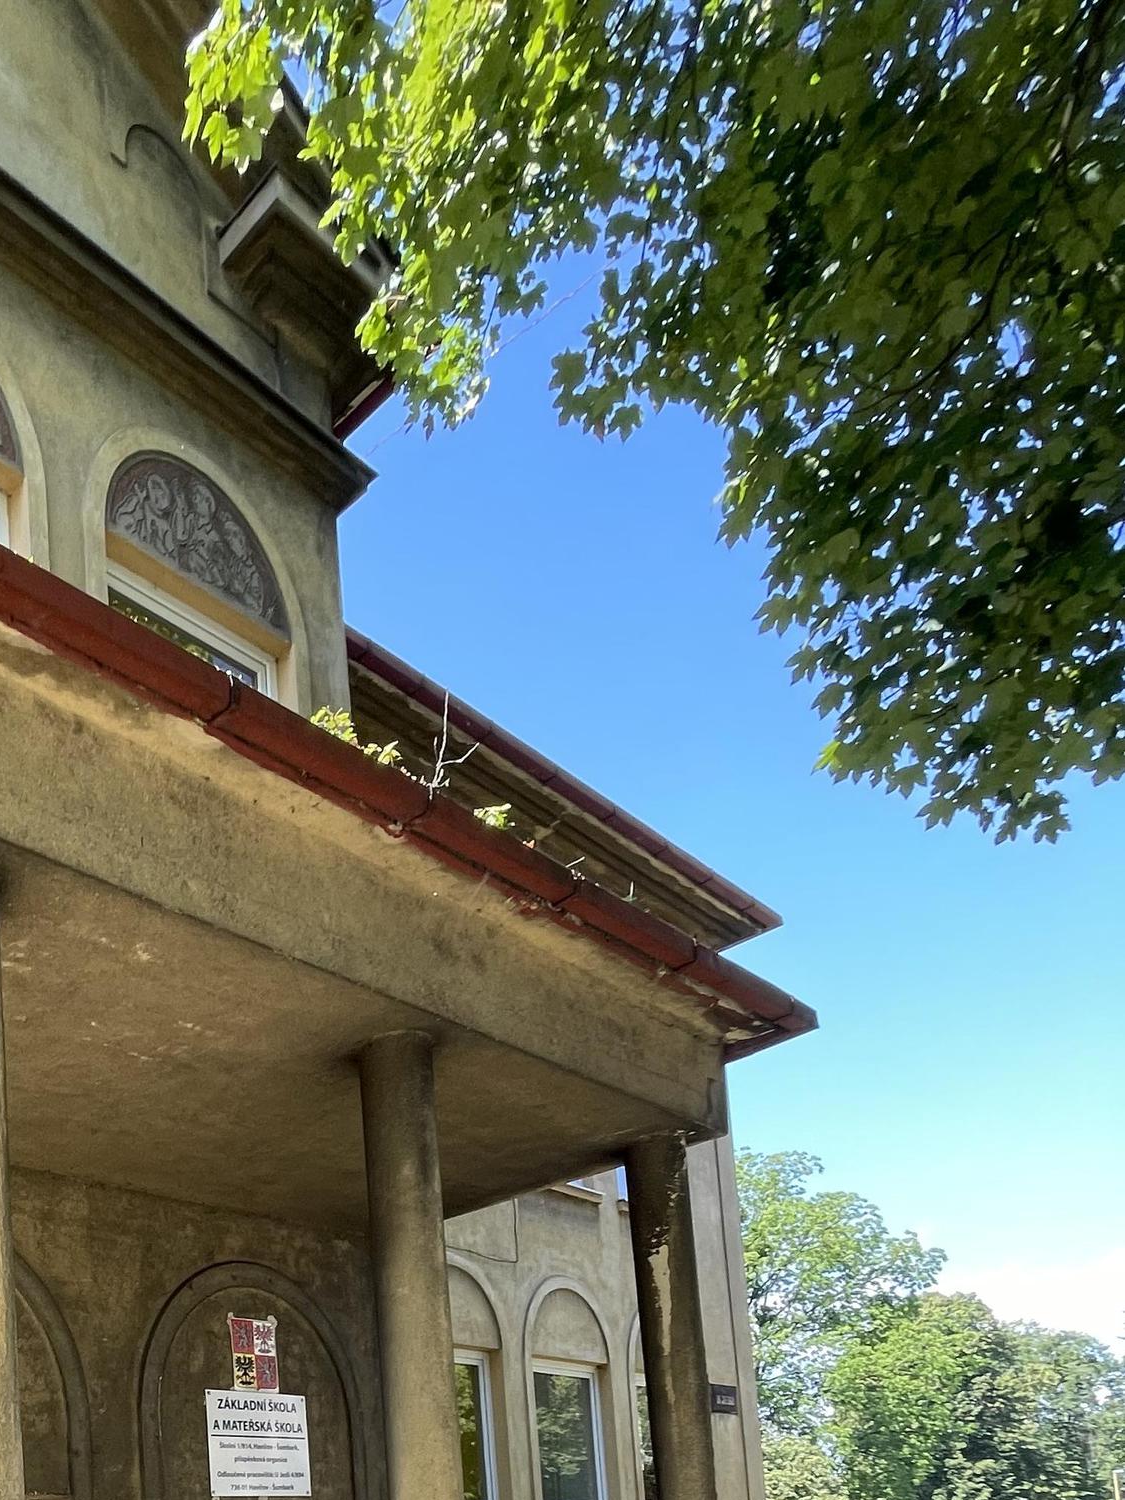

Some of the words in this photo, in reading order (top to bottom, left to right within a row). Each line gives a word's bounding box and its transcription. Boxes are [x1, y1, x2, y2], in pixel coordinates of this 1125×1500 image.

[217, 1396, 266, 1411] ZÁKLADNÍ
[268, 1399, 296, 1413] ŠKOLA
[213, 1420, 220, 1430] A
[222, 1419, 272, 1432] MATEŘSKÁ
[275, 1420, 303, 1433] ŠKOLA
